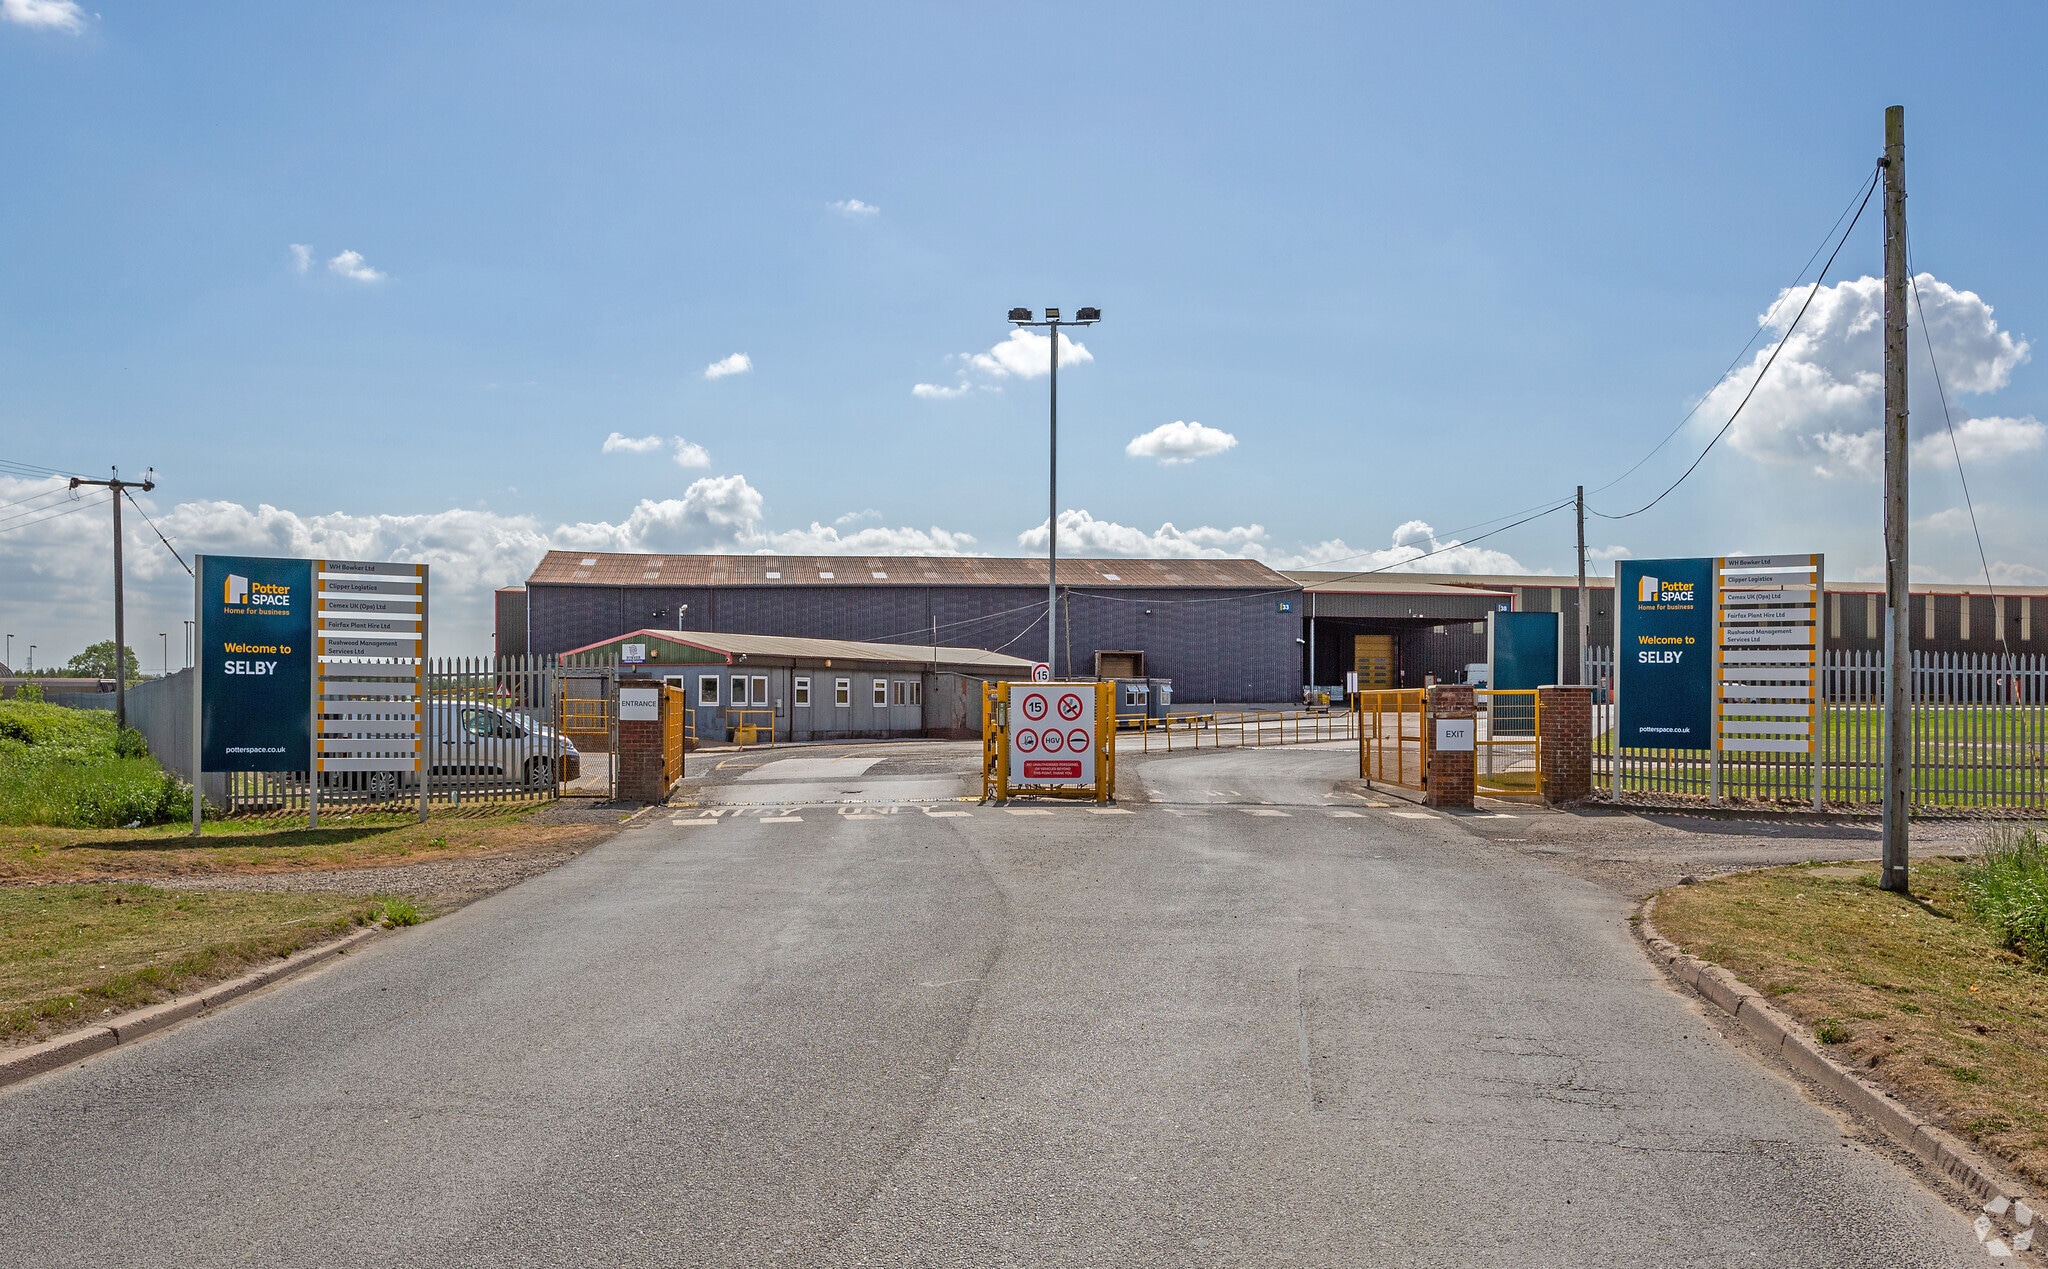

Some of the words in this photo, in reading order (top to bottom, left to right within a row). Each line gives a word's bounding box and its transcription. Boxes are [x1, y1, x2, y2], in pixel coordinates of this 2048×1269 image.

[252, 582, 290, 594] Potter
[1661, 582, 1694, 591] Potter
[252, 595, 290, 605] SPACE
[1661, 591, 1694, 601] SPACE
[246, 607, 257, 615] for
[1756, 628, 1792, 636] Management
[1638, 635, 1683, 645] Welcome
[1685, 636, 1695, 645] to
[224, 643, 277, 654] Welcome
[279, 644, 291, 654] to
[1638, 651, 1683, 664] SELBY
[224, 661, 277, 675] SELBY
[1036, 671, 1047, 680] 15
[1028, 702, 1042, 712] 15
[225, 746, 286, 754] potterspace.co.uk
